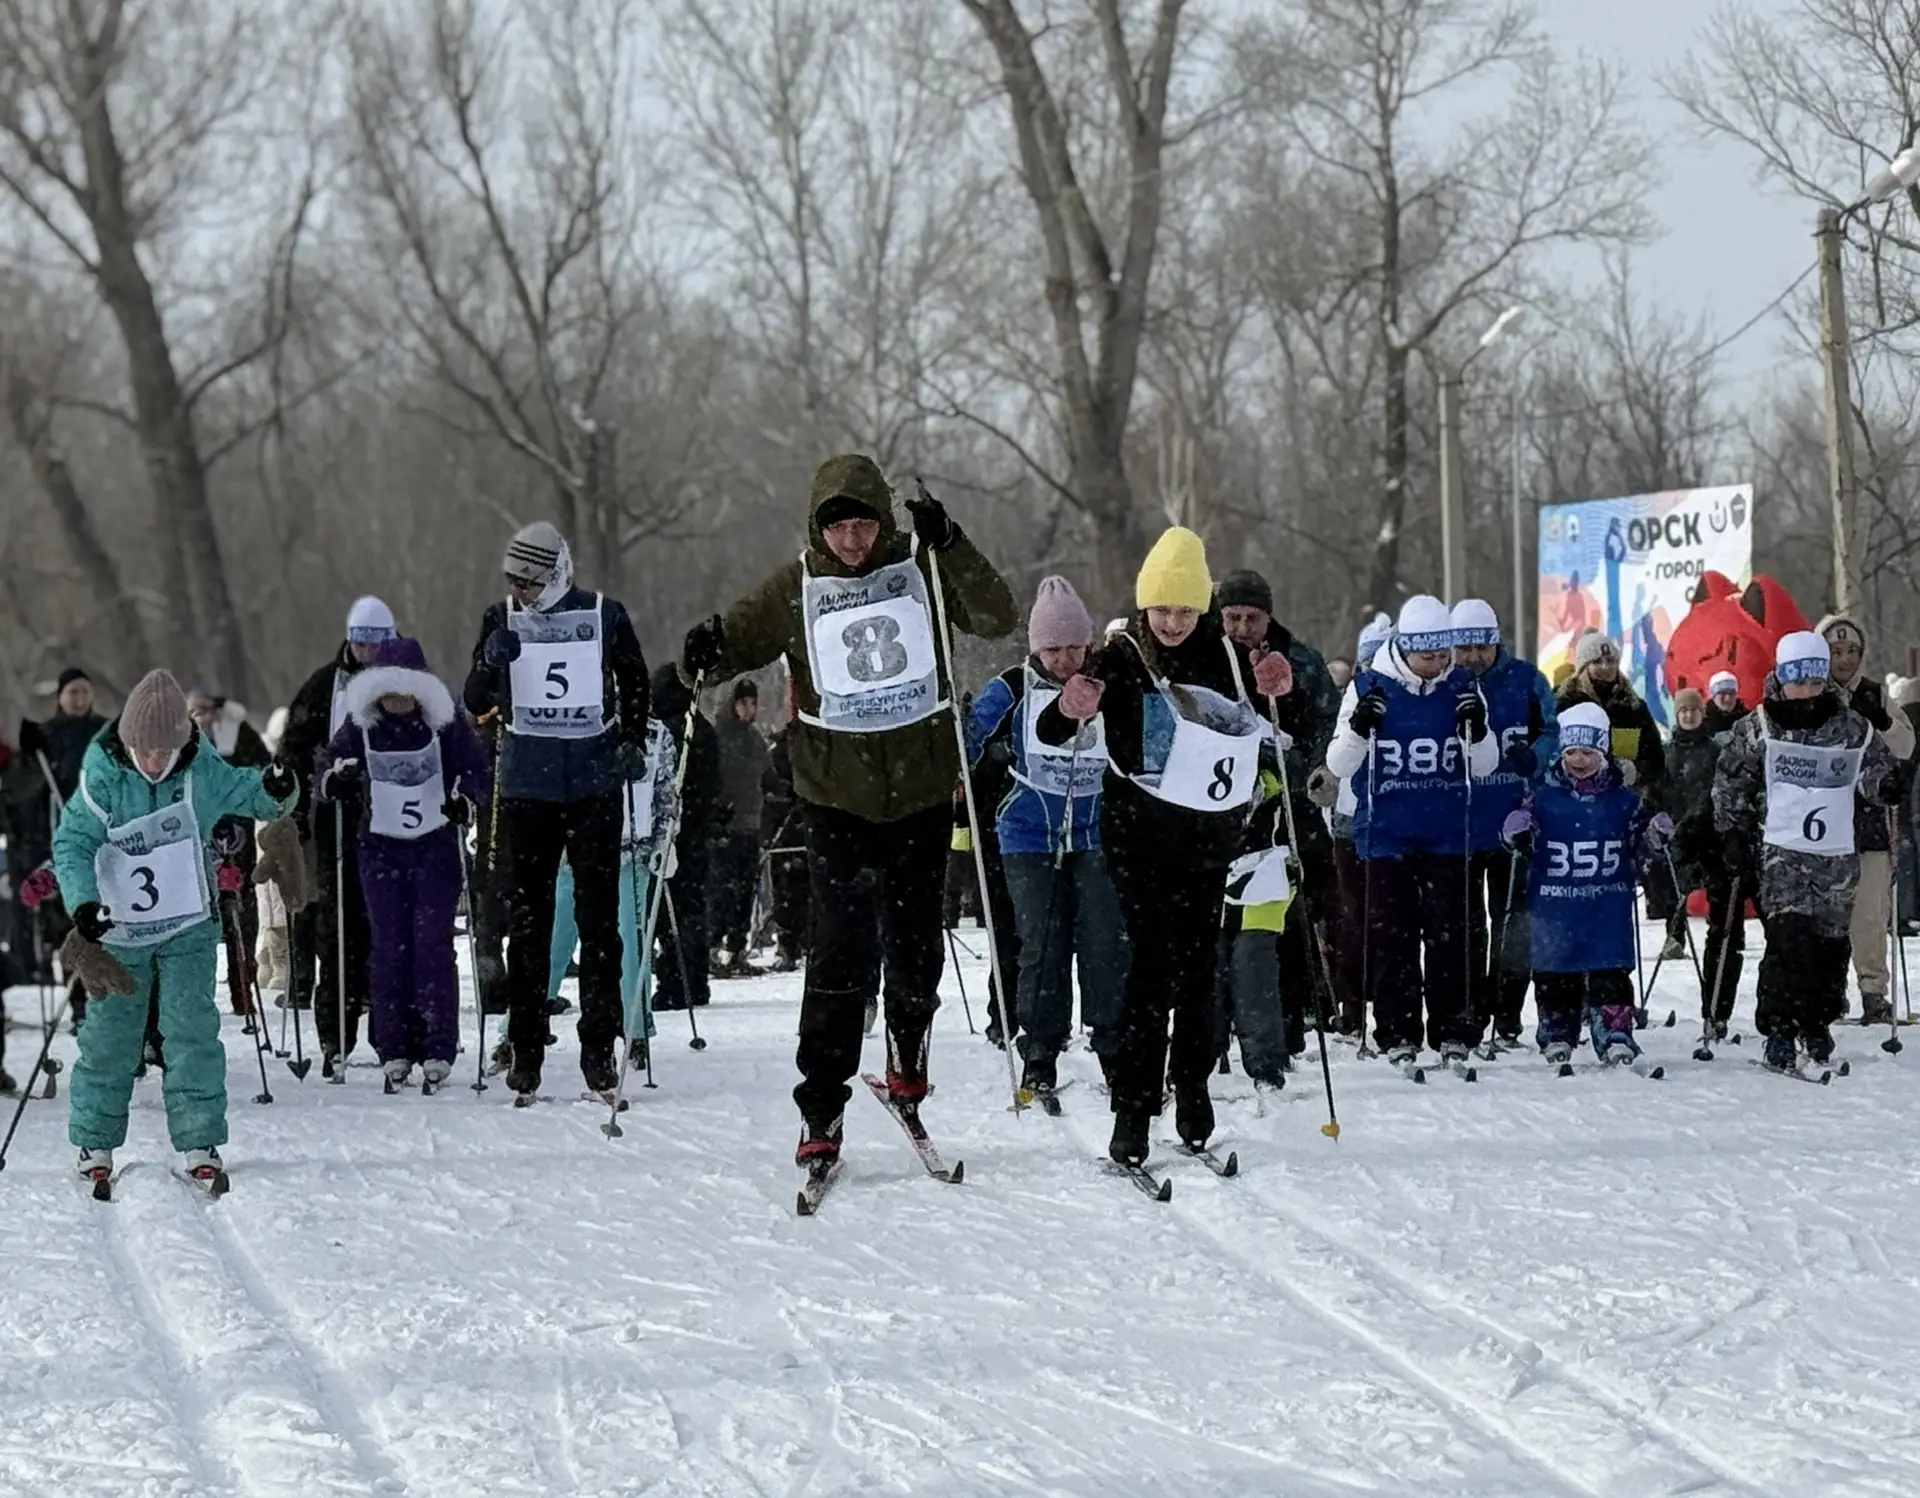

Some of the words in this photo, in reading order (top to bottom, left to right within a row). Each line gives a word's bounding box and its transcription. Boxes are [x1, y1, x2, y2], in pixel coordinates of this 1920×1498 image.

[1628, 512, 1703, 551] ОРСК
[841, 615, 908, 682] 8
[545, 661, 569, 700] 5
[1207, 756, 1235, 801] 8
[401, 800, 423, 829] 5
[1803, 805, 1828, 842] 6
[1547, 840, 1622, 877] 355
[130, 866, 160, 912] 3
